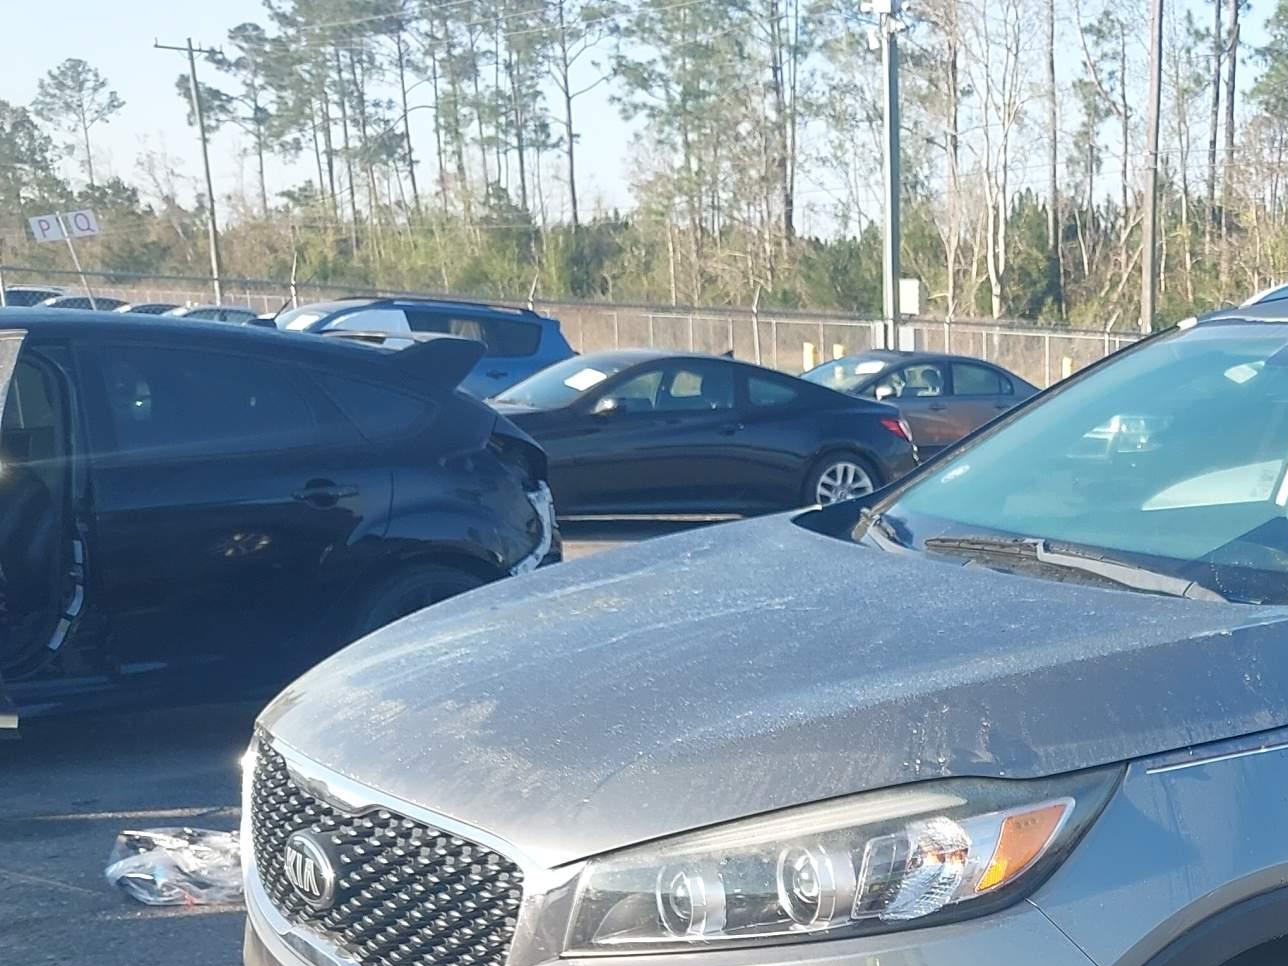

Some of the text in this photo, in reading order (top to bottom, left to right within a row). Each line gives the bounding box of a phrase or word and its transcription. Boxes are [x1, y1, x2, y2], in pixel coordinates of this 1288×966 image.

[38, 219, 51, 238] P
[74, 213, 95, 232] Q
[285, 846, 321, 896] KIA
